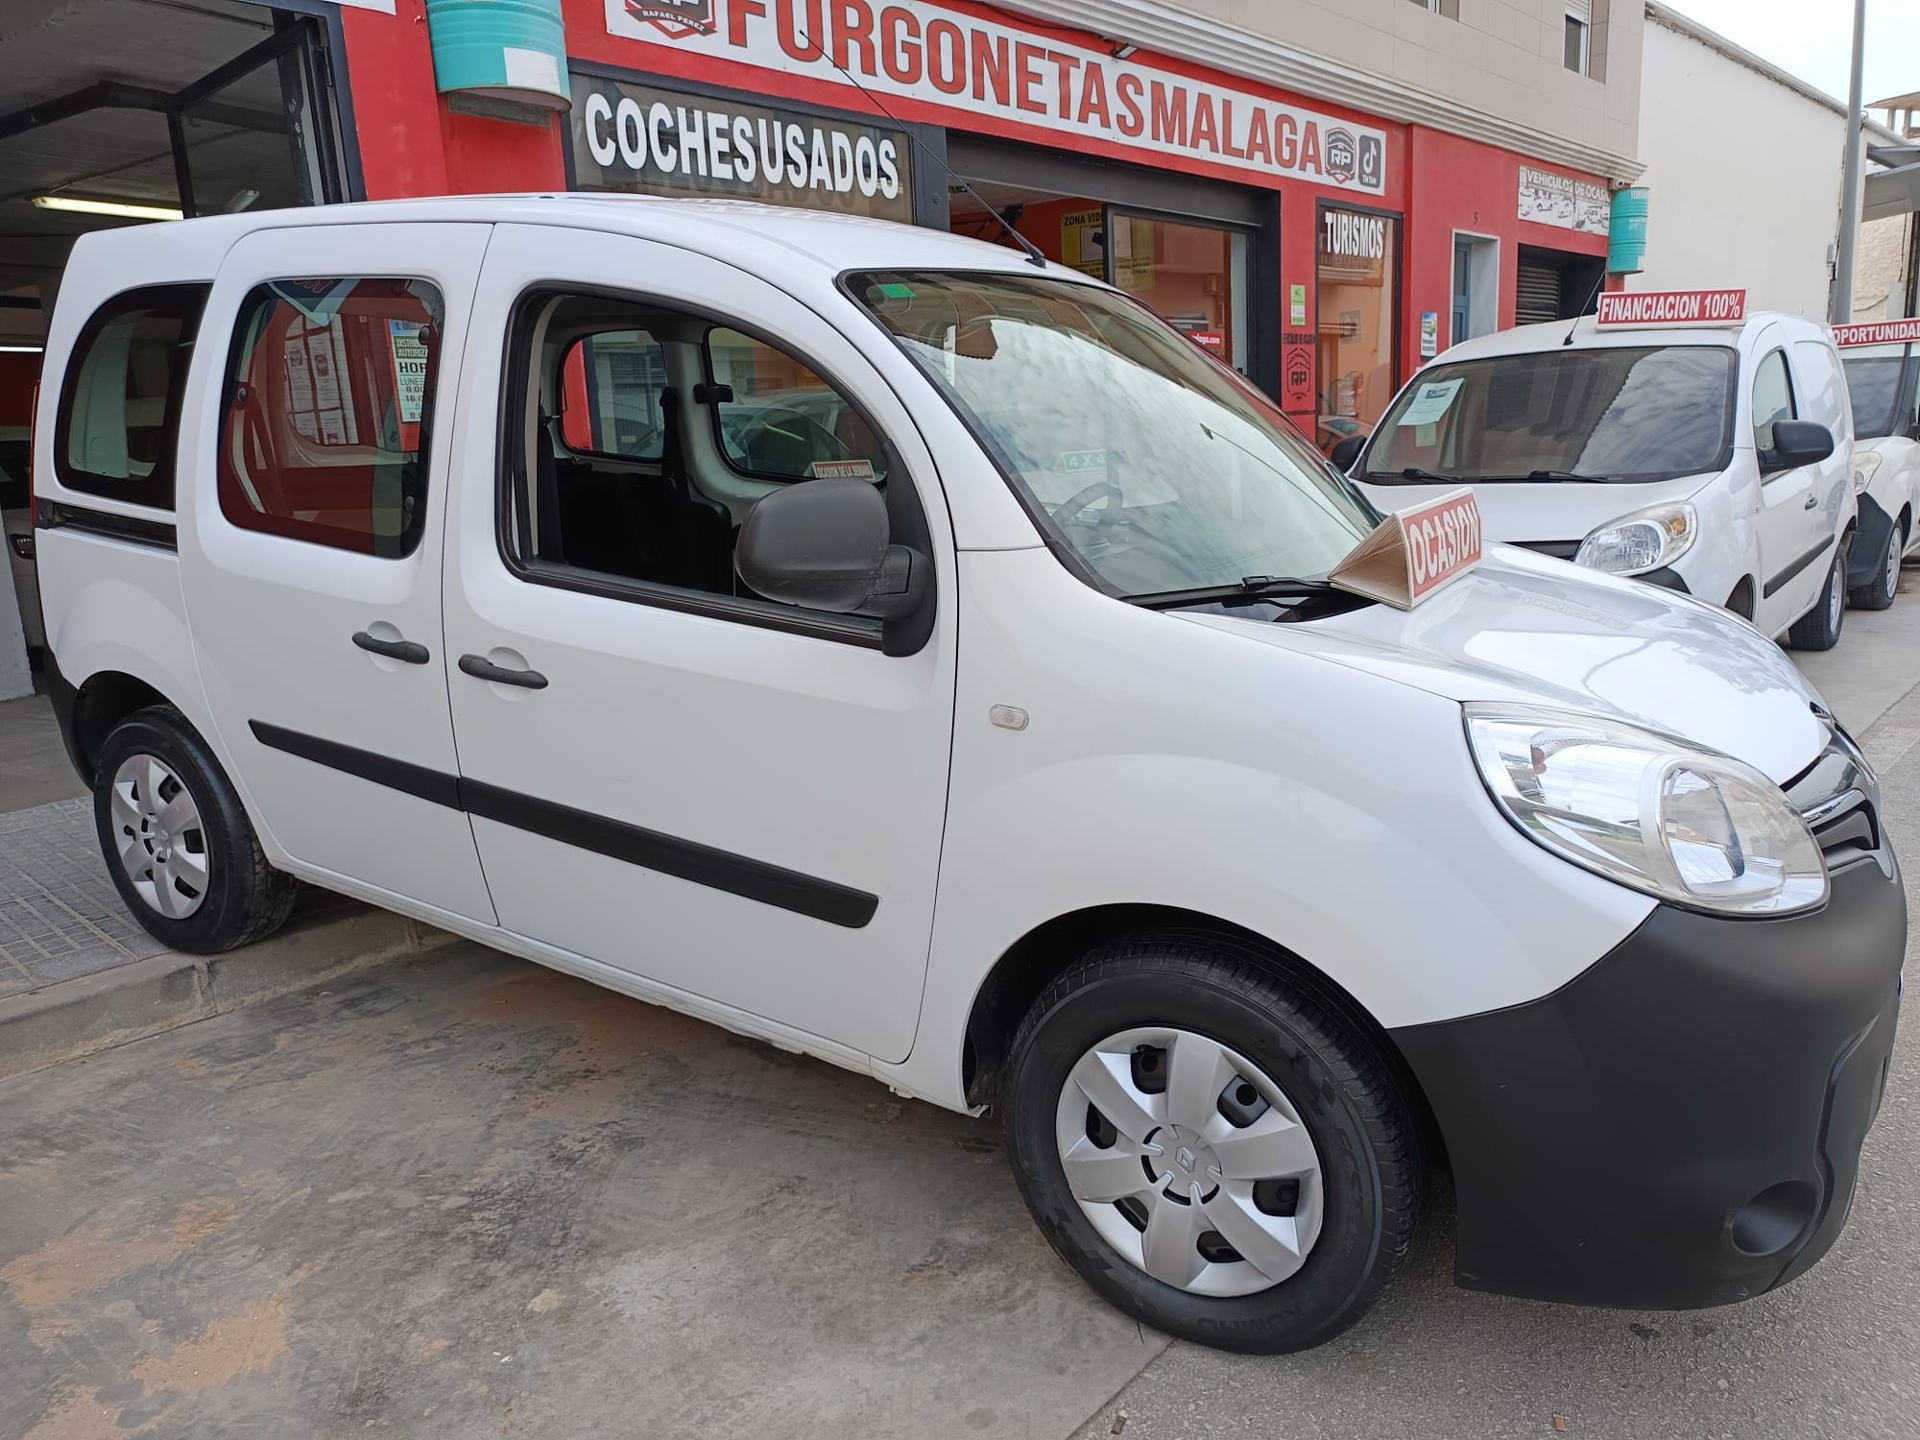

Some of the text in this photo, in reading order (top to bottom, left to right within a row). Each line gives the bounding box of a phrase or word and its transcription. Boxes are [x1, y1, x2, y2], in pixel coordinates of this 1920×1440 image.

[642, 10, 706, 31] RAFAEL PEREZ
[585, 92, 899, 200] COCHESUSADOS
[1331, 149, 1352, 166] RP
[1526, 170, 1574, 191] VEHICULOS
[1574, 181, 1585, 197] DE
[1064, 214, 1085, 226] ZONA
[1472, 212, 1479, 225] 5
[1325, 211, 1384, 260] TURISMOS
[1600, 292, 1741, 321] FINANCIACION 100%
[1409, 501, 1480, 585] OCASION
